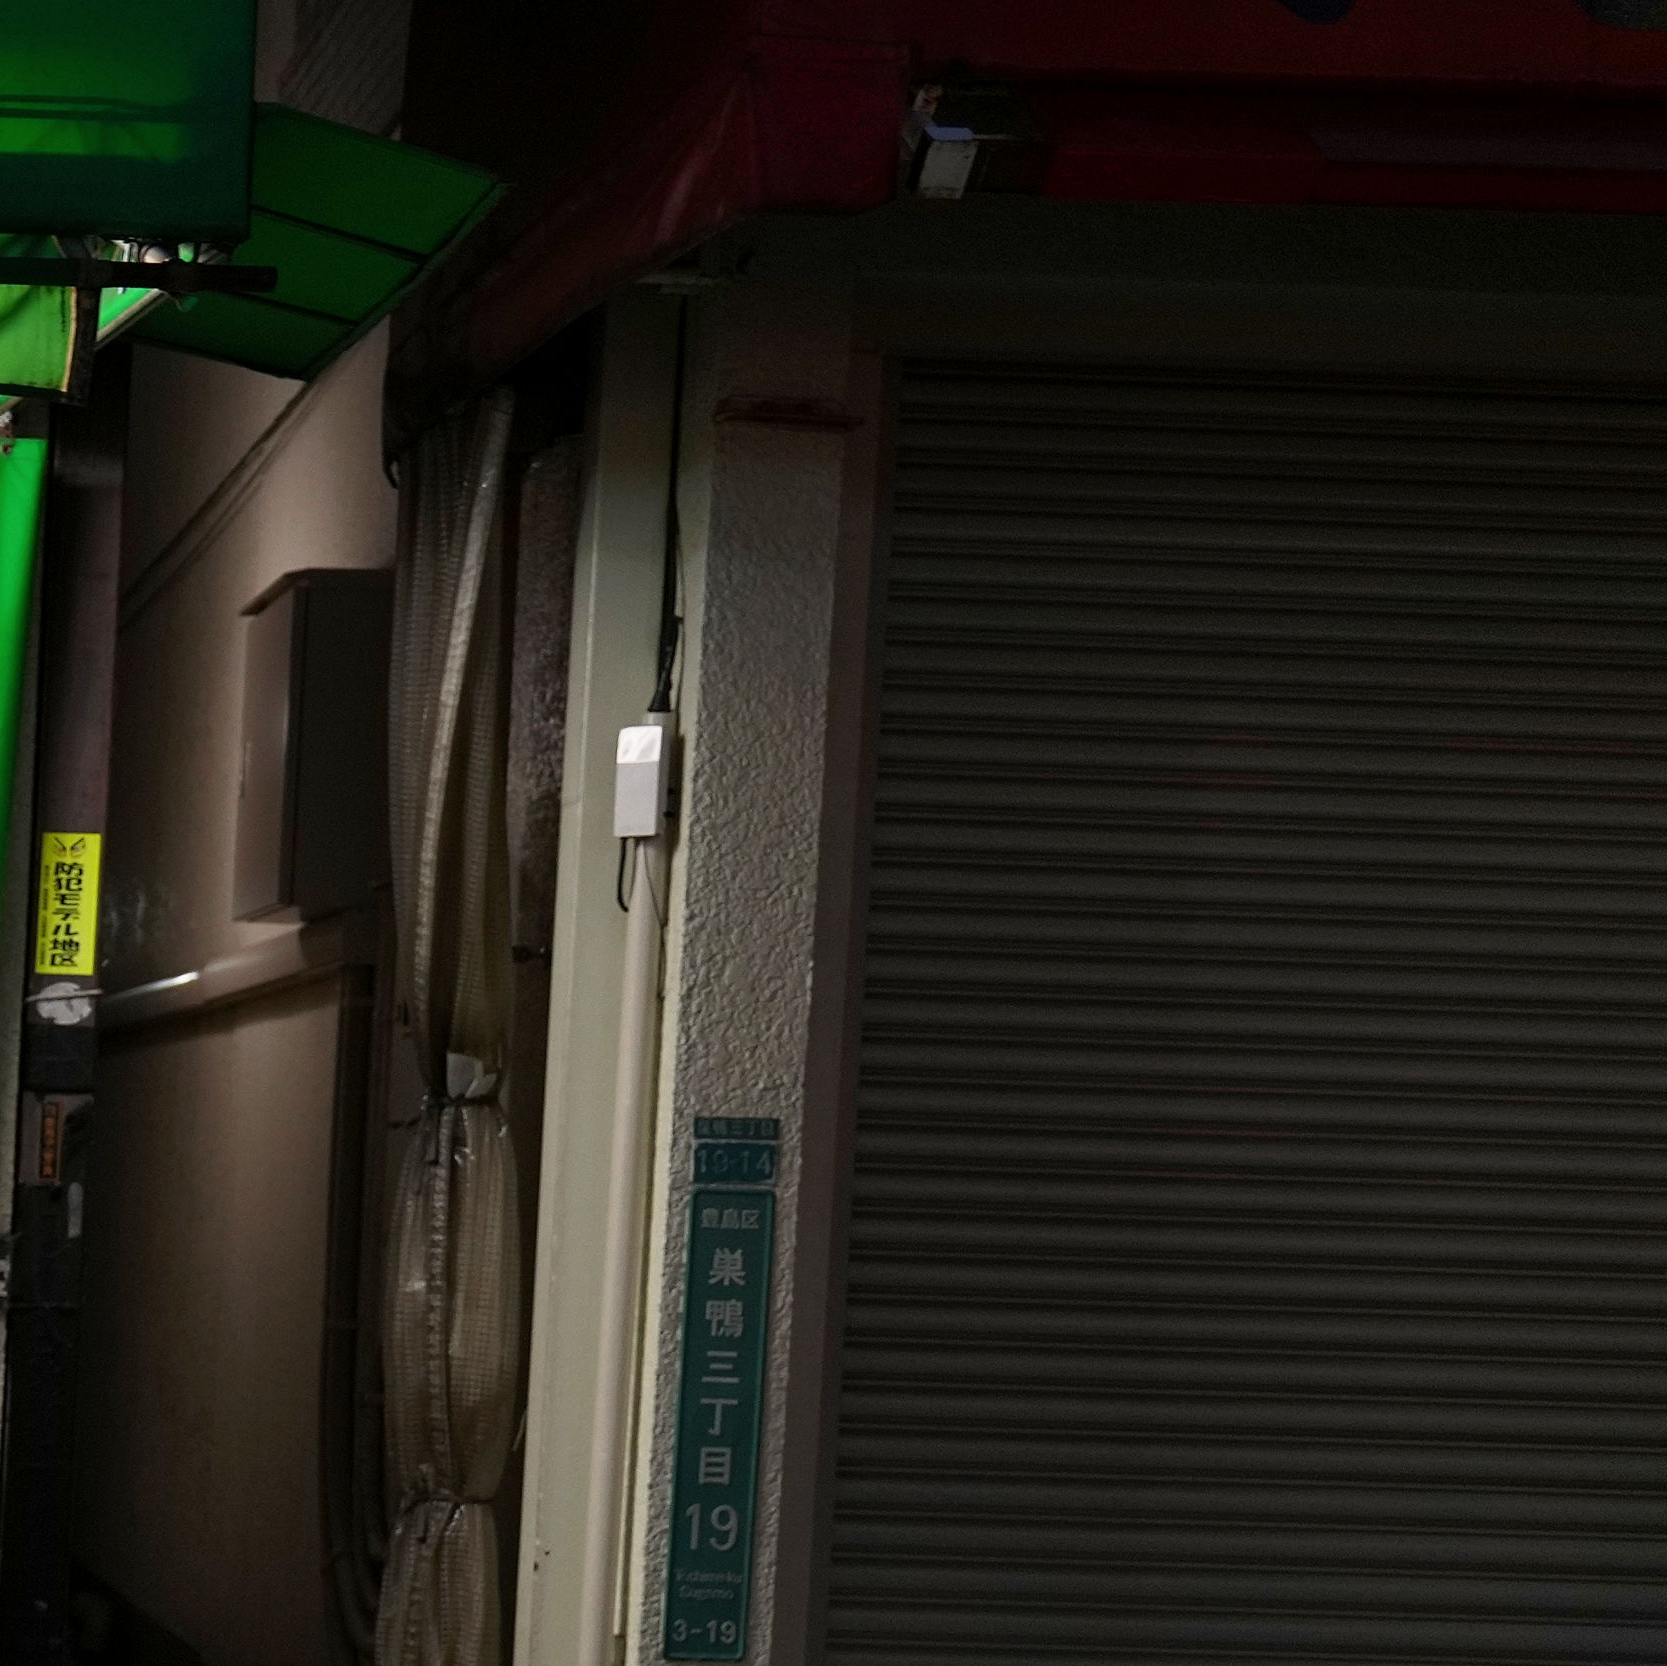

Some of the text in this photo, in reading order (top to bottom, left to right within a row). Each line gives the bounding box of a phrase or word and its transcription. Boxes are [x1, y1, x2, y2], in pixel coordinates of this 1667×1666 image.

[50, 861, 83, 966] 防犯モデル地区
[700, 1207, 762, 1230] 豊島区
[684, 1247, 747, 1553] 巣鴨三丁目 19
[670, 1618, 738, 1645] 3-19
